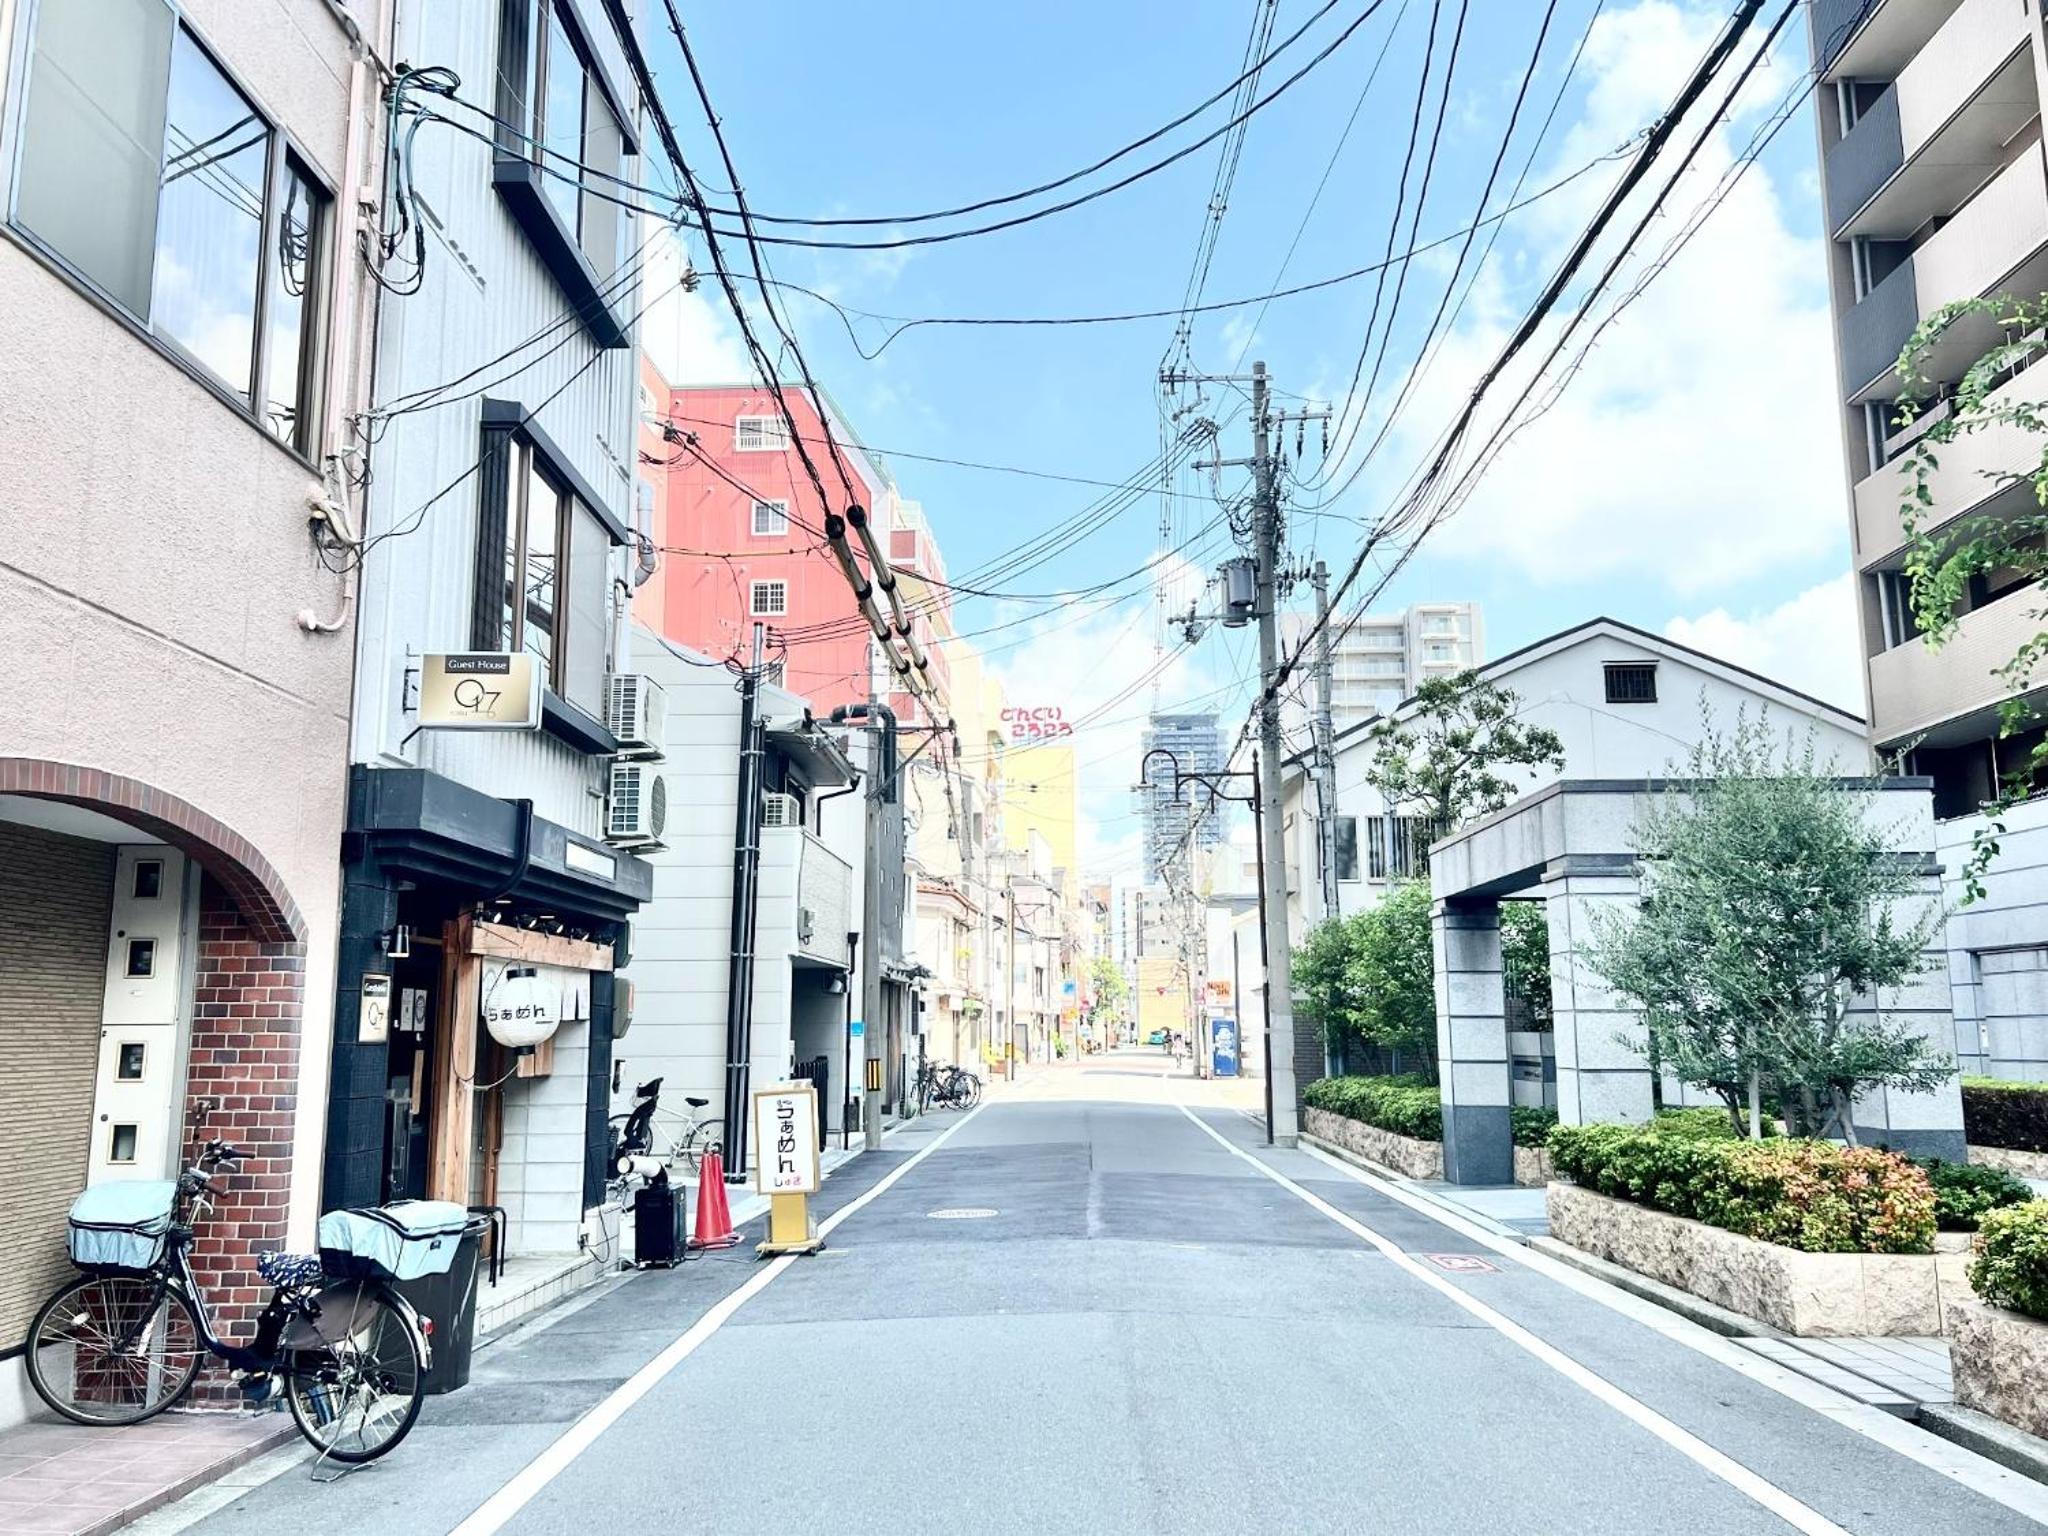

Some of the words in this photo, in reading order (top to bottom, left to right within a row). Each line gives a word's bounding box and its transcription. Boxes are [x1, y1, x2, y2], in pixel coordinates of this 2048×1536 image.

[448, 659, 475, 669] Guest
[478, 660, 507, 670] House
[1000, 707, 1061, 721] どんぐり
[1012, 723, 1073, 737] ころころ
[488, 1004, 546, 1022] らぁめん
[776, 1099, 796, 1174] らぁめん
